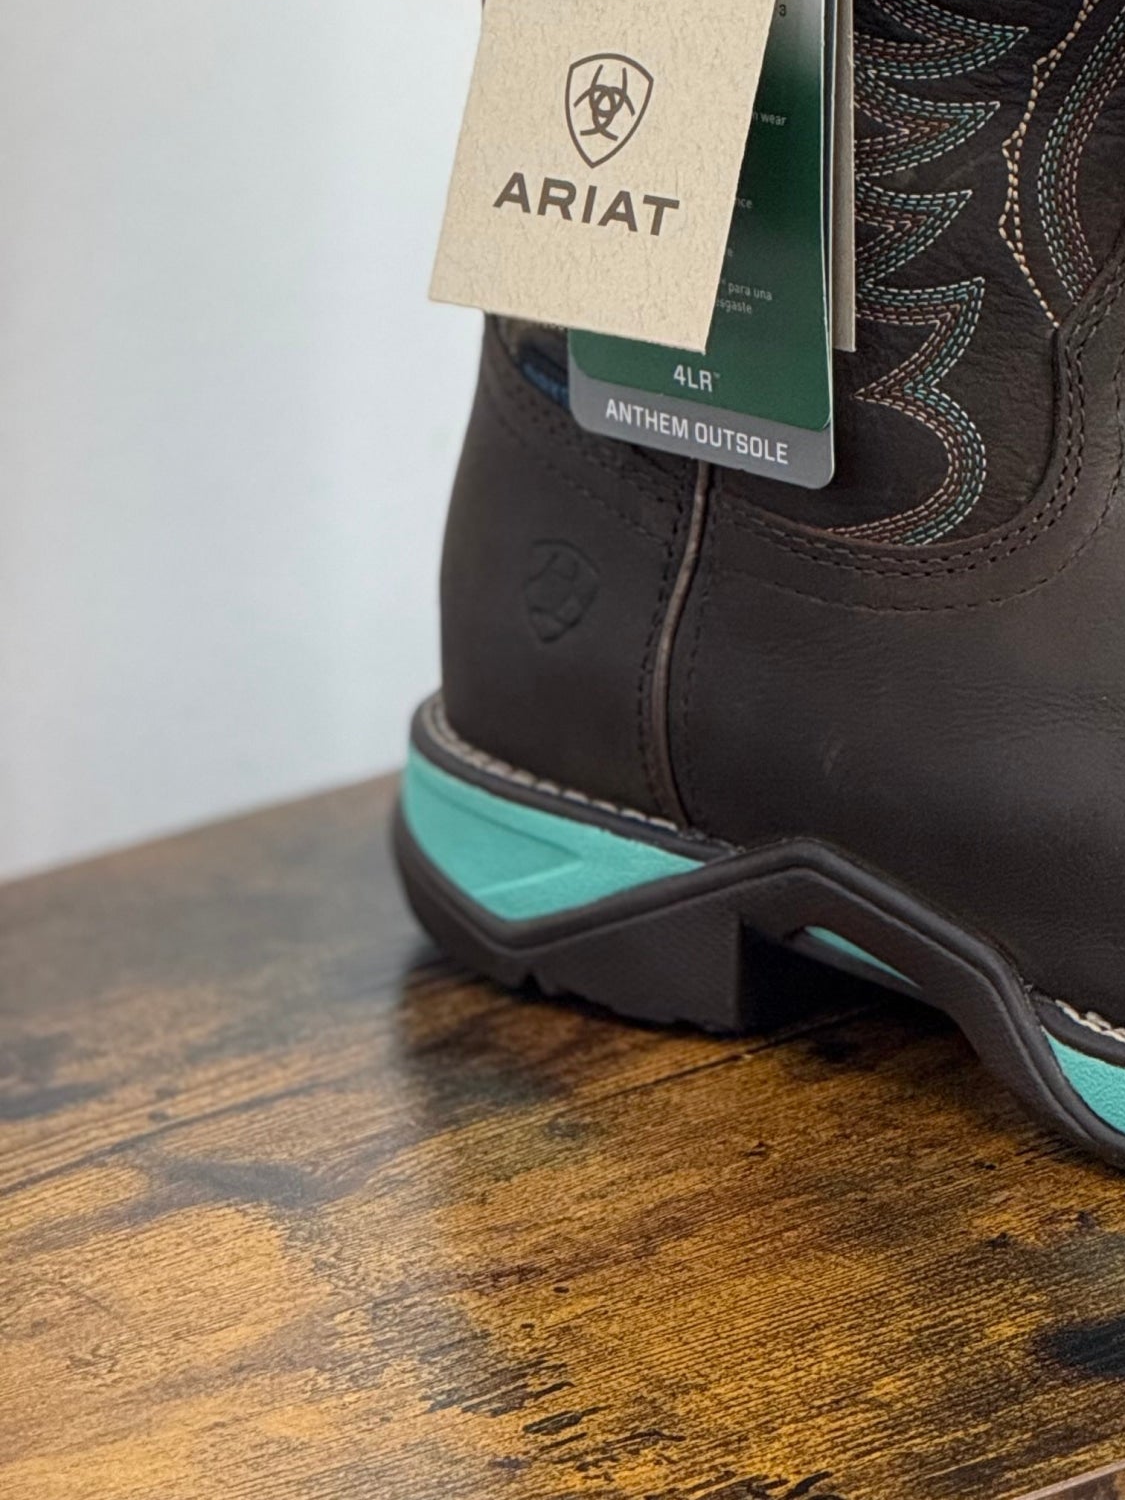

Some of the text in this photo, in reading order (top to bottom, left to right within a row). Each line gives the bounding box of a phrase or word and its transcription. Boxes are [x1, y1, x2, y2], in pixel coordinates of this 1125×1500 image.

[761, 112, 787, 126] wear
[493, 172, 680, 236] ARIAT
[727, 281, 773, 301] para una
[605, 398, 789, 465] ANTHEM OUTSOLE
